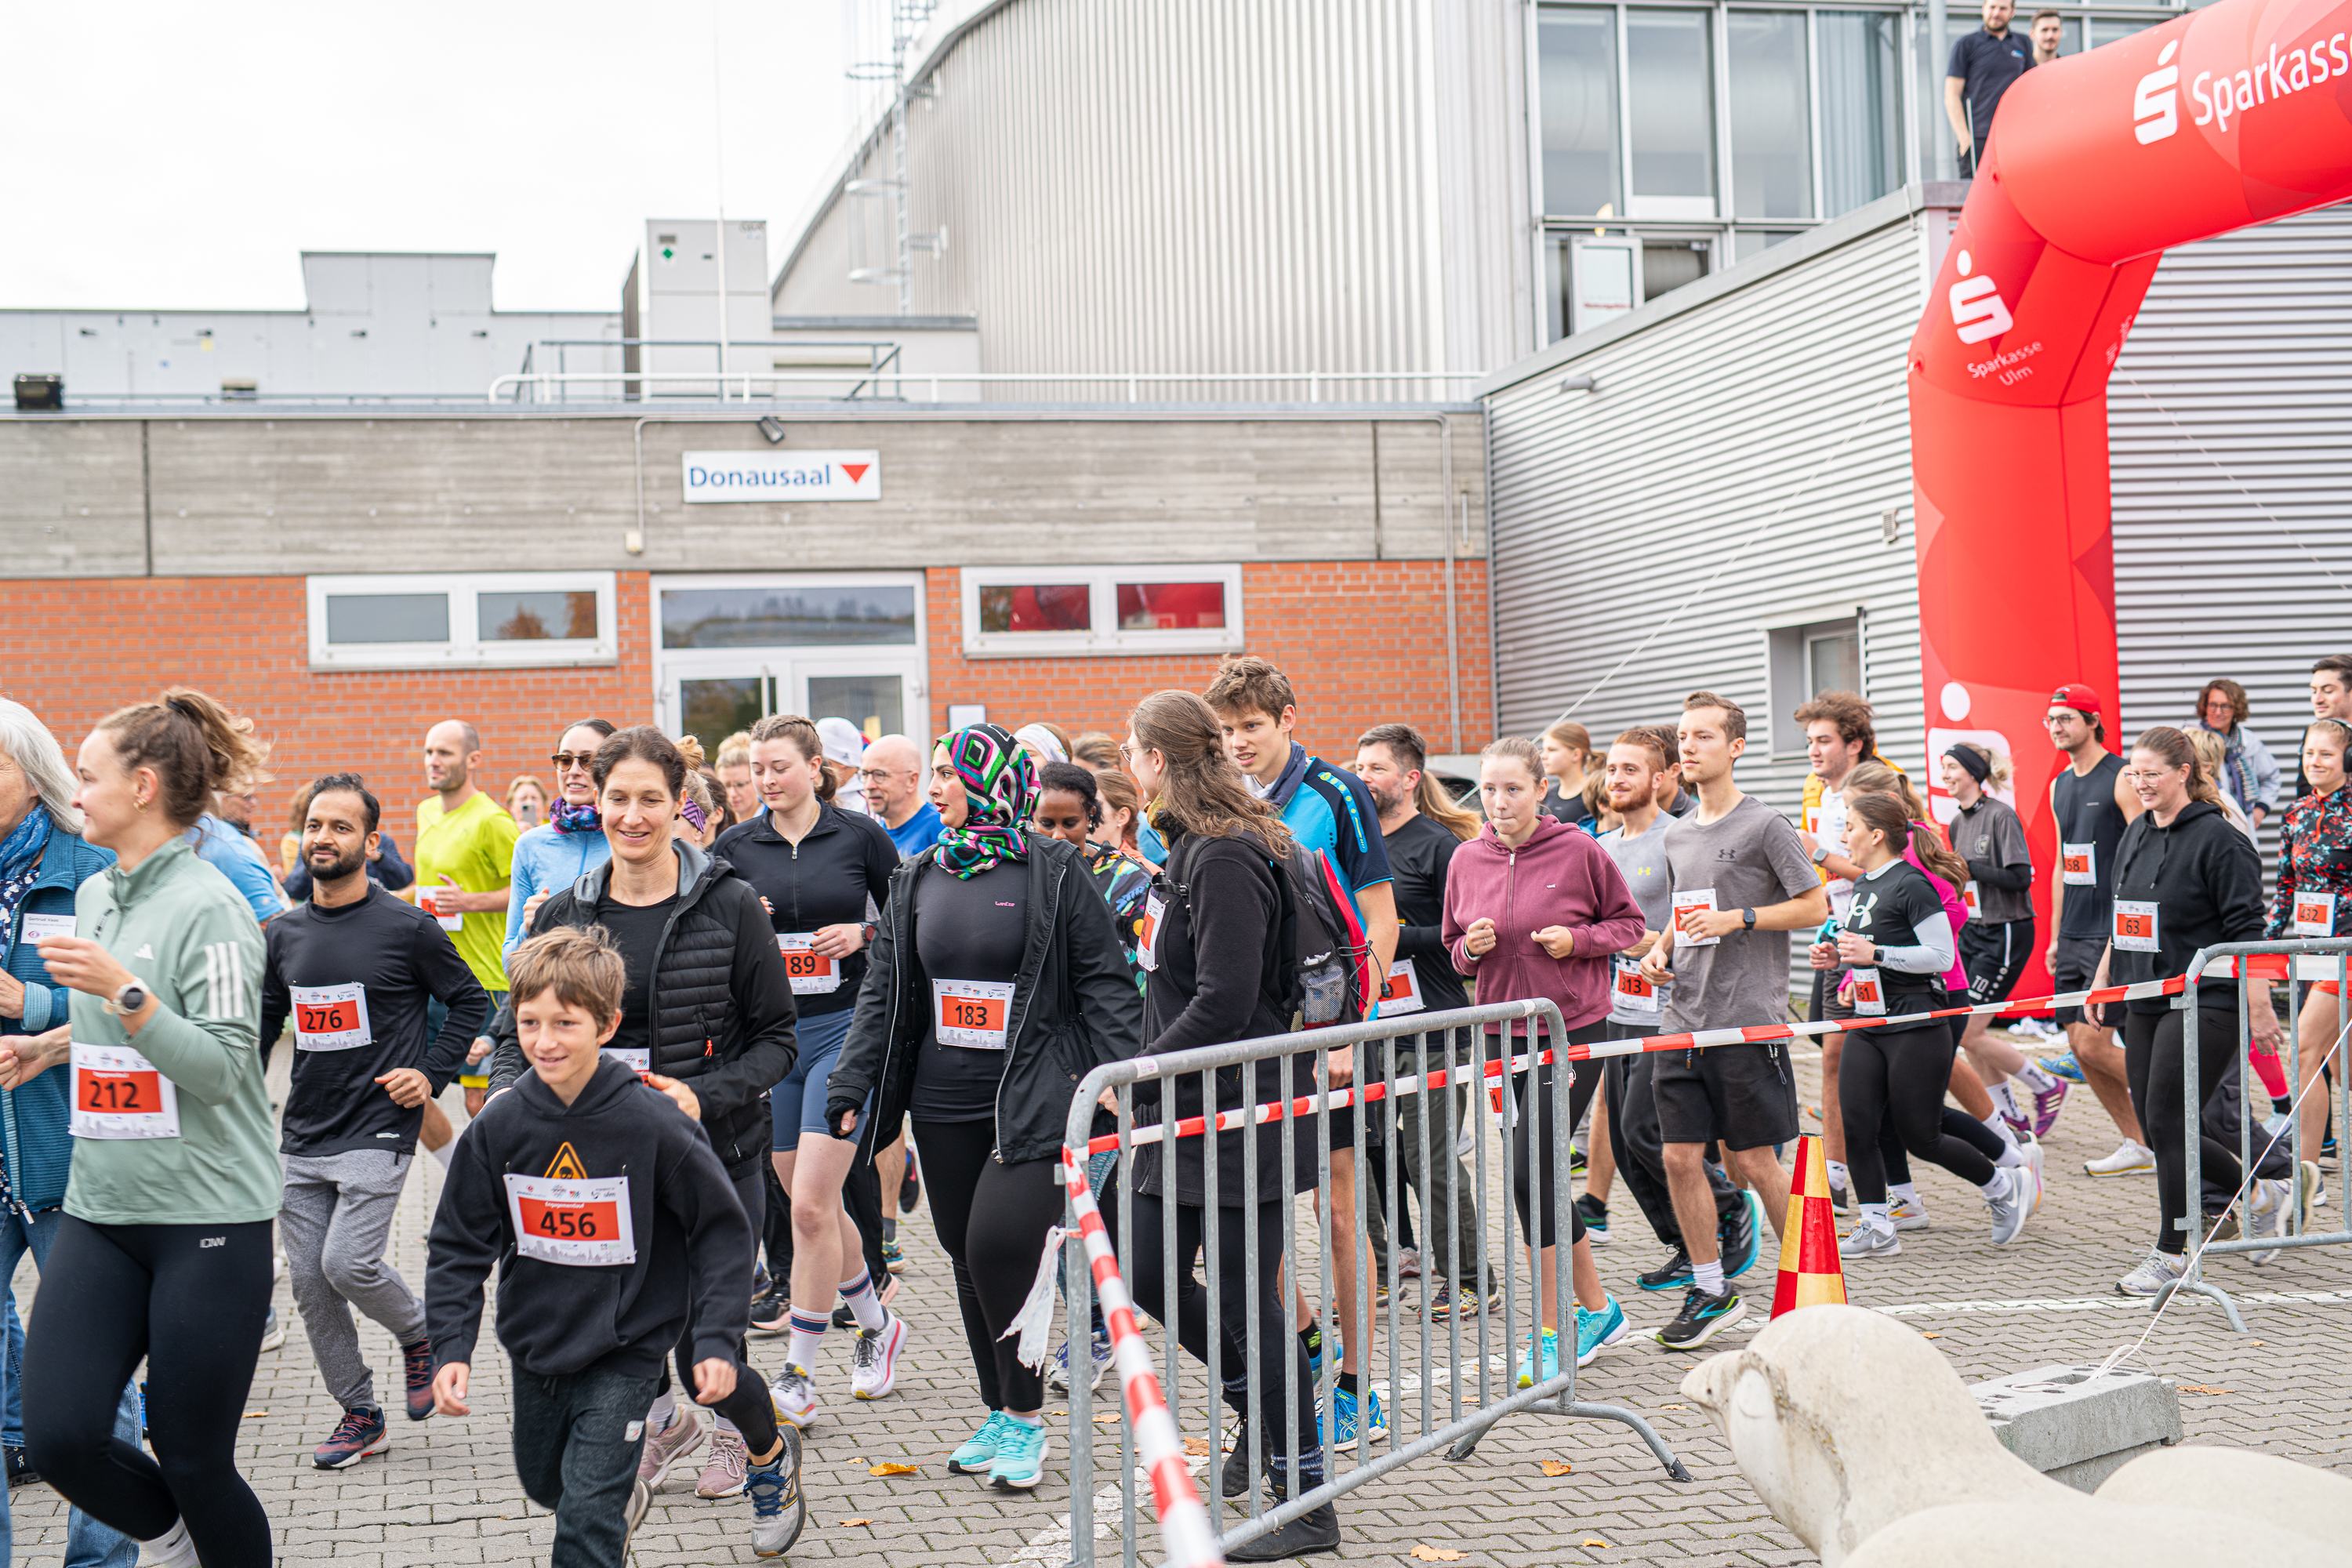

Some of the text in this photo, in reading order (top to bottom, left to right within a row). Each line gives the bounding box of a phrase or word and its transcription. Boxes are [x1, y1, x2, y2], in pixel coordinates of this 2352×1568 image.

[2192, 32, 2352, 133] Sparkass
[1967, 341, 2044, 379] Sparkasse
[1999, 366, 2034, 386] Ulm
[690, 463, 830, 487] Donausaal
[2299, 908, 2318, 922] 432
[2126, 920, 2140, 935] 63
[1621, 976, 1642, 994] 313
[305, 1009, 343, 1030] 276
[955, 1004, 987, 1026] 183
[89, 1080, 140, 1108] 212
[540, 1210, 597, 1237] 456
